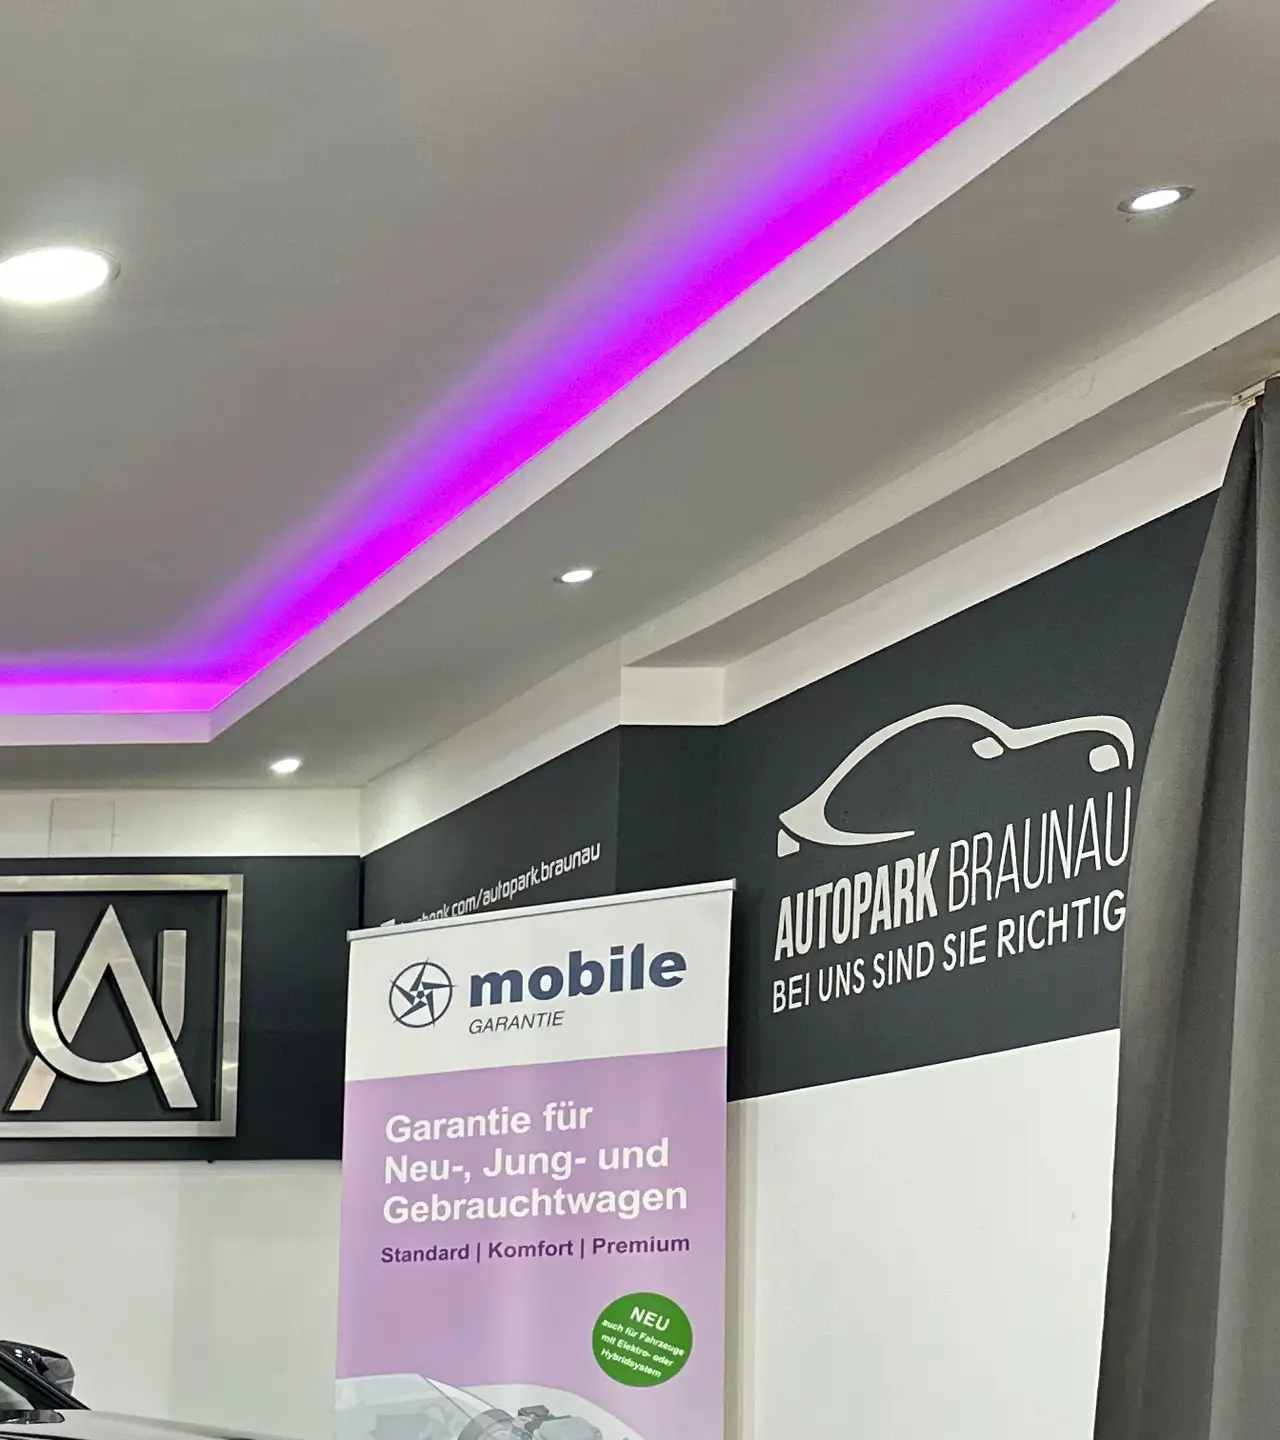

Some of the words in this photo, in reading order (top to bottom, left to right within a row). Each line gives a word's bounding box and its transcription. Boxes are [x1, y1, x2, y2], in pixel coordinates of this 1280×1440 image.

[773, 846, 940, 962] AUTOPARK
[947, 785, 1132, 914] BRAUNAU
[772, 970, 811, 1014] BEI
[817, 958, 866, 1003] UNS
[872, 940, 936, 990] SIND
[942, 924, 988, 972] SIE
[996, 888, 1127, 959] RICHTIG
[469, 942, 688, 1009] mobile
[468, 1009, 566, 1036] GARANTIE
[384, 1105, 532, 1144] Garantie
[542, 1100, 594, 1132] für
[383, 1154, 472, 1184] Neu-,
[482, 1147, 587, 1181] Jung-
[597, 1136, 670, 1171] und
[382, 1184, 688, 1225] Gebrauchtwagen
[380, 1243, 471, 1264] Standard
[488, 1238, 575, 1260] Komfort
[591, 1234, 691, 1256] Premium
[601, 1319, 624, 1333] auch
[624, 1326, 639, 1338] für
[639, 1331, 685, 1357] Fahrzeuge
[629, 1306, 671, 1332] NEU
[600, 1347, 662, 1378] Hybridsystem
[601, 1334, 617, 1345] mit
[616, 1338, 652, 1358] Elektro-
[652, 1353, 675, 1368] oder
